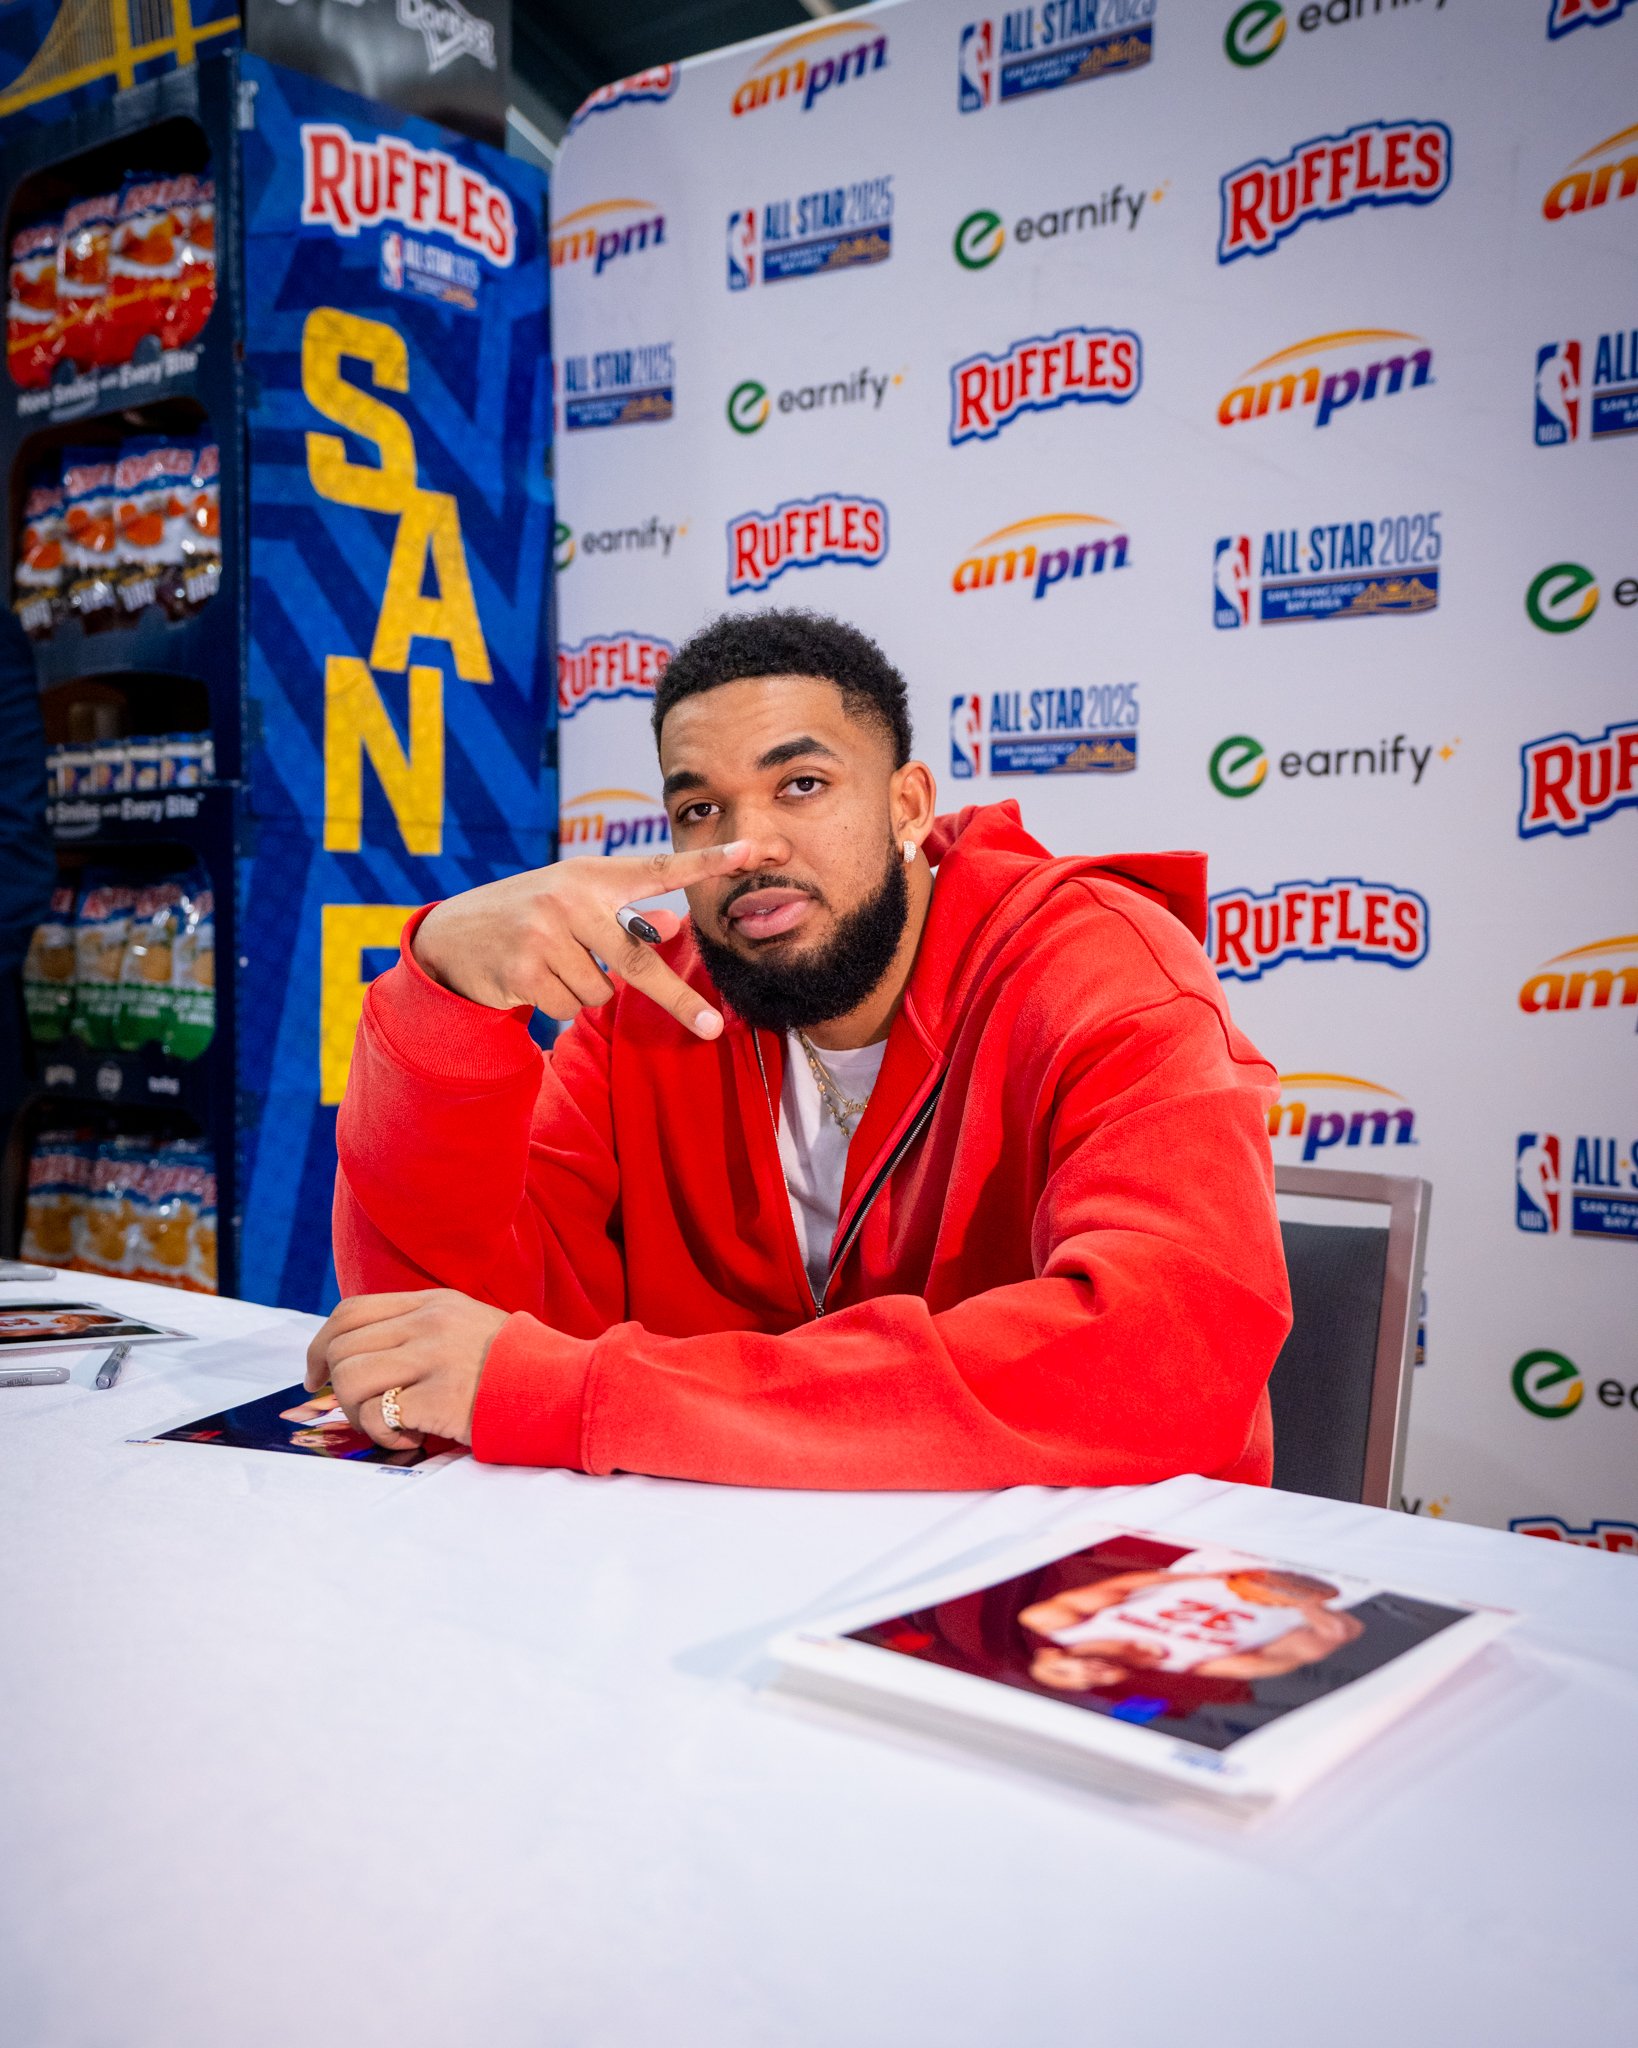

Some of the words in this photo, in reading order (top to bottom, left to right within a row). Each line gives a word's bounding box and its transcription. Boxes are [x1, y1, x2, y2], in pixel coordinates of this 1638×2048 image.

[731, 35, 888, 117] ampm
[305, 131, 512, 259] RUFFLES
[1015, 185, 1147, 242] earnify
[1228, 131, 1445, 247] RUFFLES
[551, 215, 666, 275] mpm
[778, 367, 889, 414] earnify
[958, 336, 1132, 431] RUFFLES
[1217, 347, 1433, 428] ampm
[582, 516, 676, 558] earnify
[734, 503, 882, 590] RUFFLES
[952, 533, 1130, 600] ampm
[1378, 511, 1442, 566] 2025
[1087, 682, 1140, 728] 2025
[1280, 735, 1432, 785] earnify
[560, 811, 669, 857] mpm
[1215, 889, 1420, 968] RUFFLES
[1268, 1101, 1416, 1161] mpm
